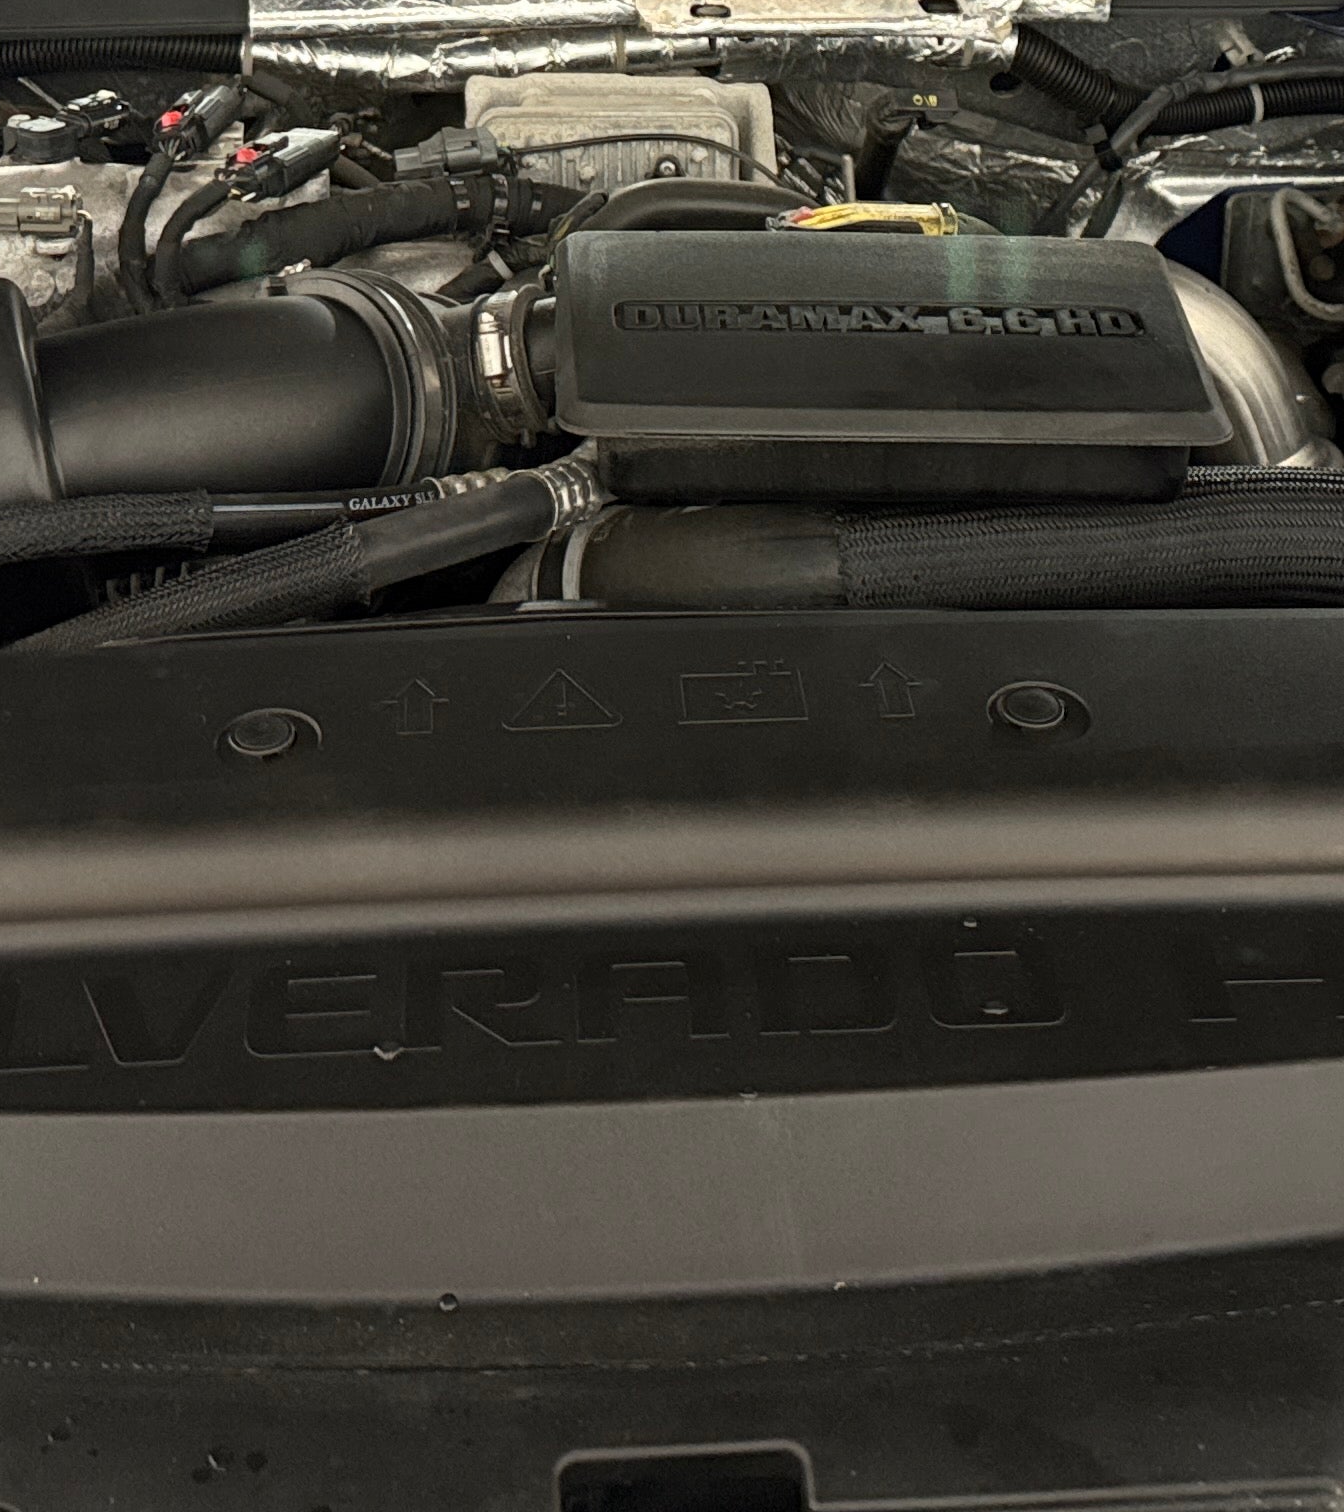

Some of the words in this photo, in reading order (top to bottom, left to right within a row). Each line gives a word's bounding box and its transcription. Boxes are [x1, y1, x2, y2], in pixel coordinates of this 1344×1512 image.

[626, 301, 922, 334] DURAMAX
[947, 305, 1042, 336] 6.6
[1058, 307, 1140, 338] HD
[349, 494, 412, 511] GALAXY
